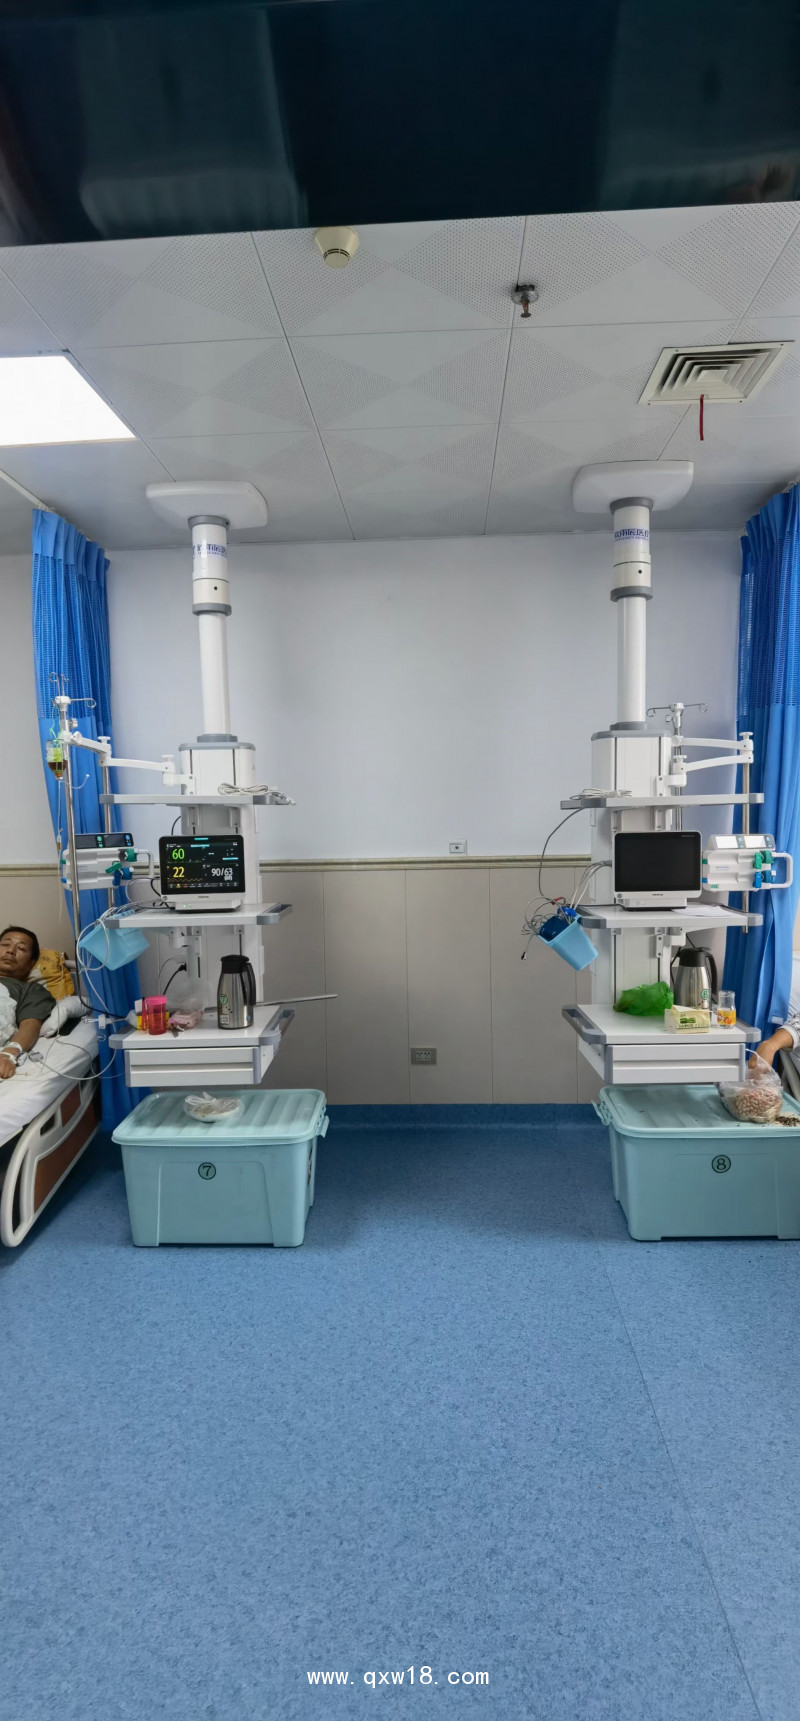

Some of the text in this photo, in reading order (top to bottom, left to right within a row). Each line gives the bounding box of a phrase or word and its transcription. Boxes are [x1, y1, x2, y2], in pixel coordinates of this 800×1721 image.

[172, 848, 185, 860] 60
[172, 866, 185, 878] 22
[211, 867, 233, 877] 90/63
